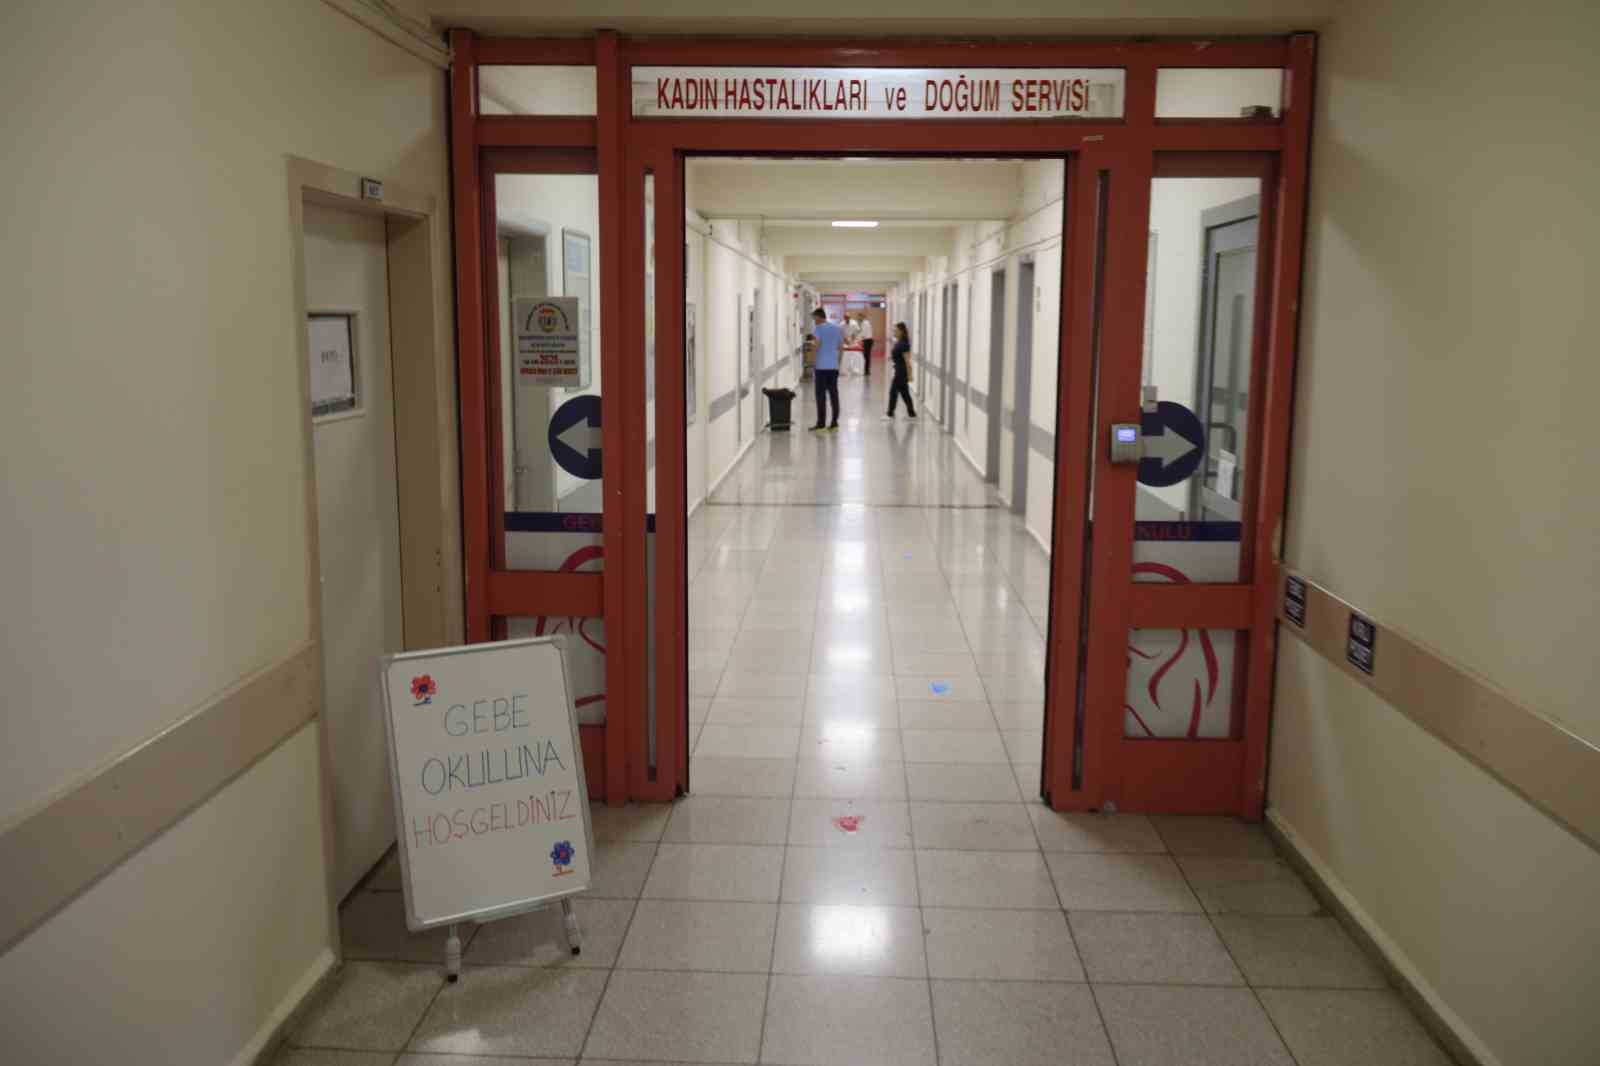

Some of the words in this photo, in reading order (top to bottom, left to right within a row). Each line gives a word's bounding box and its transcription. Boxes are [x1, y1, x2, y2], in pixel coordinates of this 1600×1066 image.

[657, 78, 718, 110] KADIN
[724, 78, 867, 111] HASTALIKLARI
[884, 87, 907, 111] ve
[925, 75, 999, 111] DOĞUM
[444, 694, 530, 736] GEBE
[422, 740, 566, 795] OKULUNA
